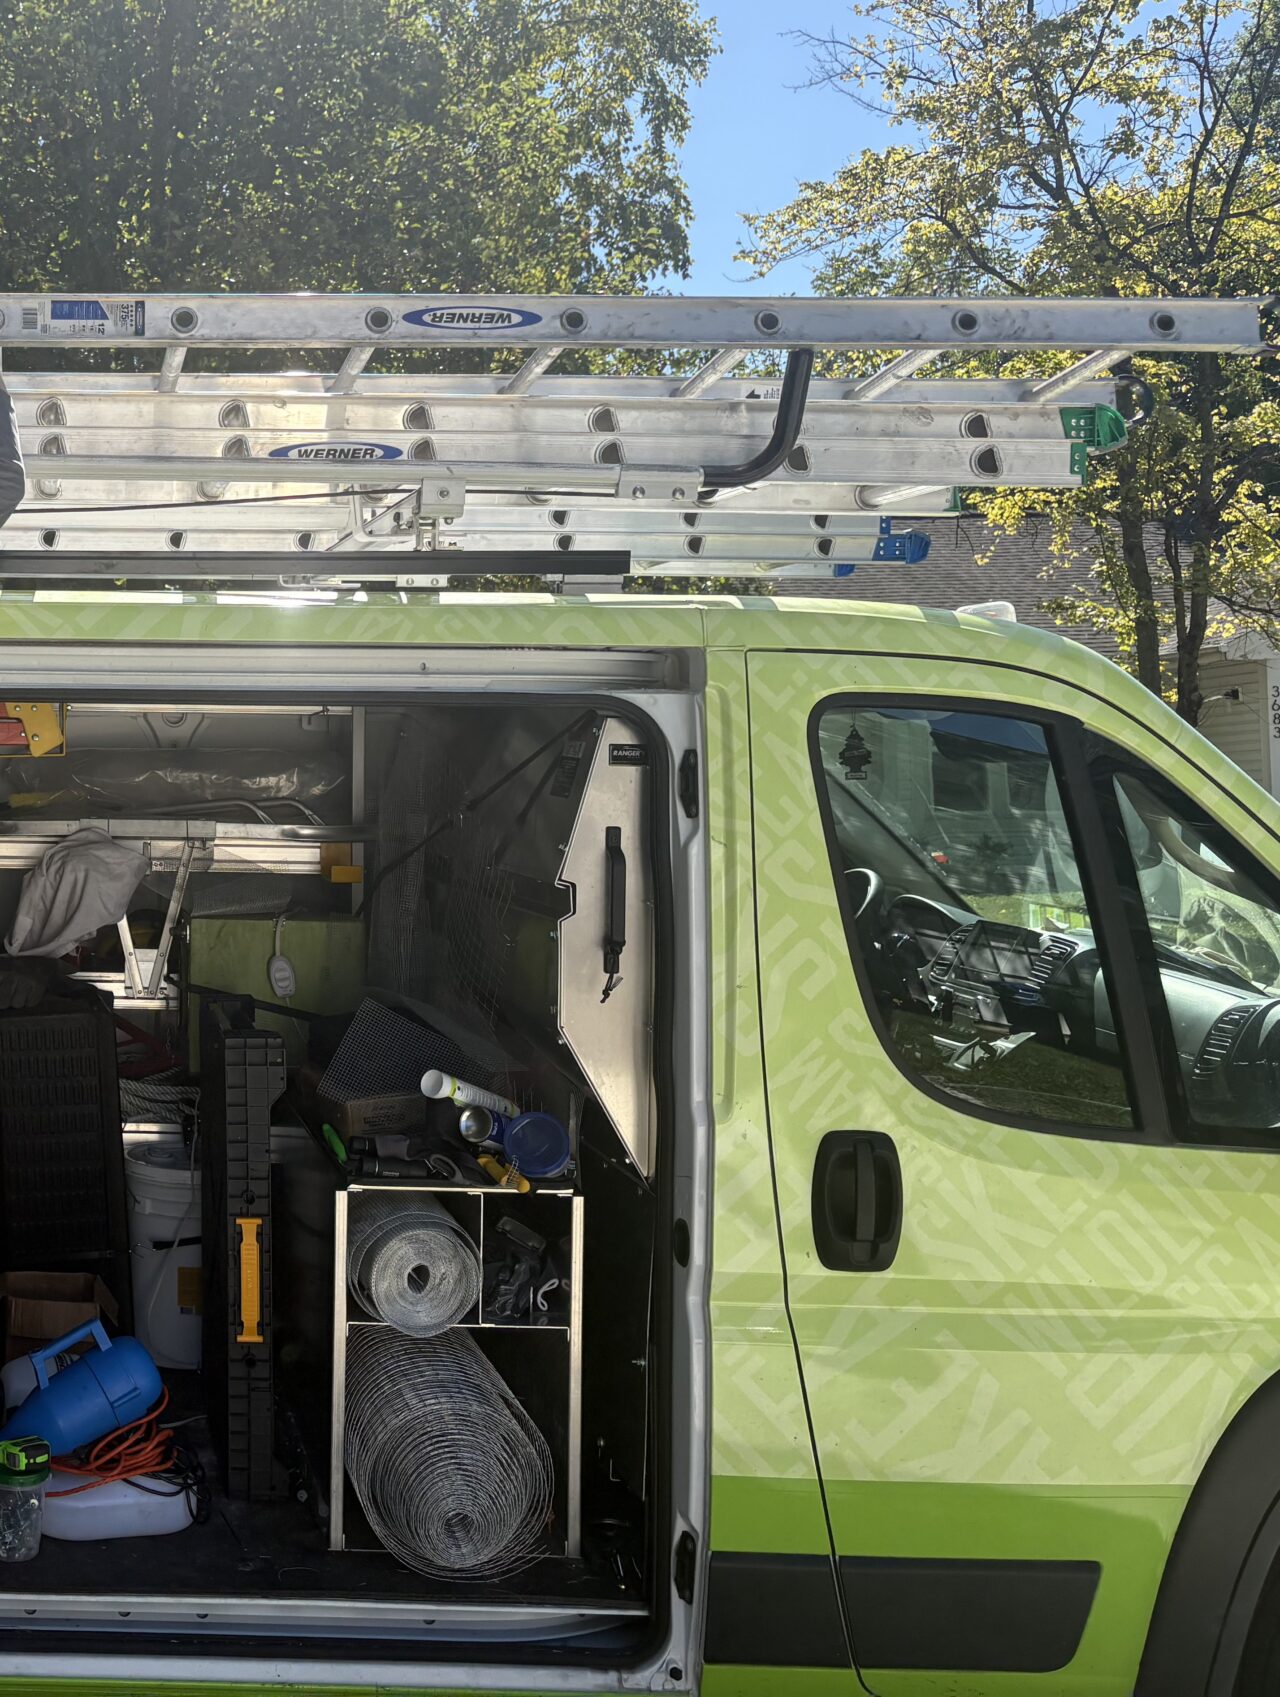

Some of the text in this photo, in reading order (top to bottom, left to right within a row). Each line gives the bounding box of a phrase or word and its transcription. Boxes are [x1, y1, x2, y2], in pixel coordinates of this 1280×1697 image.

[431, 312, 512, 324] WERNER
[297, 447, 376, 459] WERNER
[612, 749, 641, 757] RANGER
